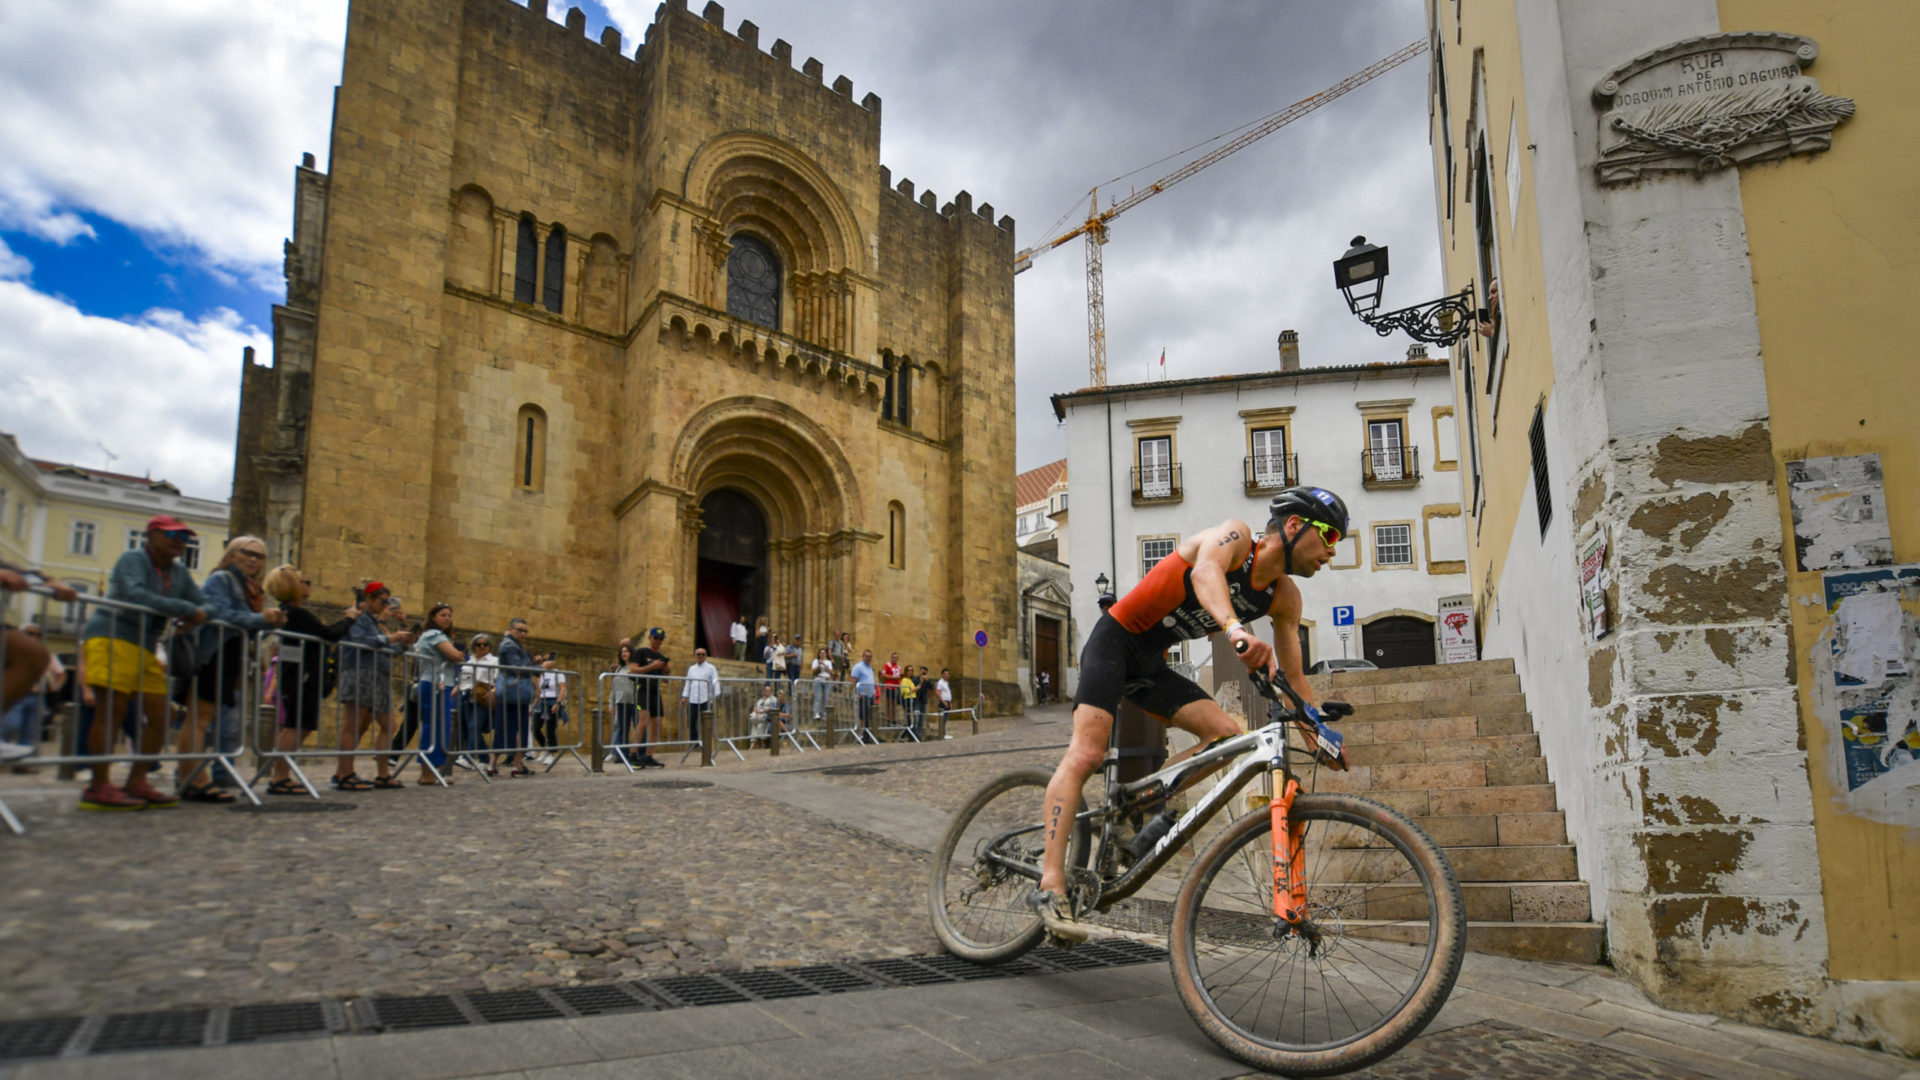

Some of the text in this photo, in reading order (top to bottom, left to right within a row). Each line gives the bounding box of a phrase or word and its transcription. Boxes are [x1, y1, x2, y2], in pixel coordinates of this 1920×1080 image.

[1680, 52, 1724, 74] RUA
[1696, 70, 1712, 81] DE
[1738, 64, 1799, 86] D'AGUIAR
[1316, 490, 1331, 502] 11
[1336, 607, 1350, 625] P
[1048, 804, 1062, 841] 011
